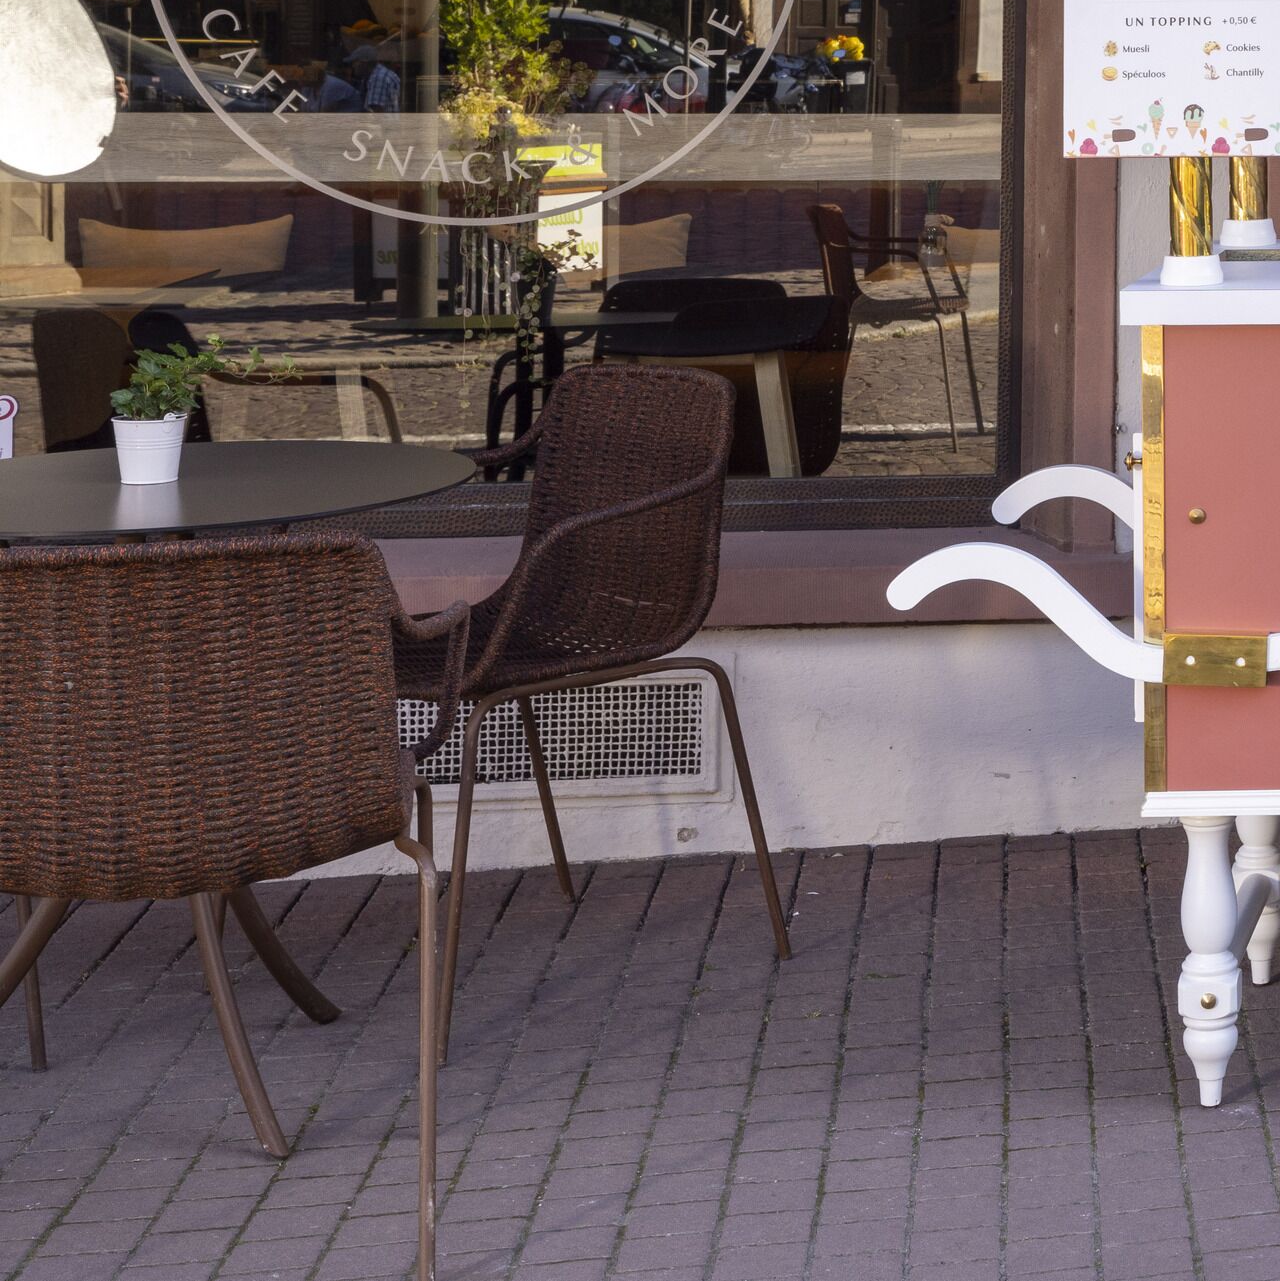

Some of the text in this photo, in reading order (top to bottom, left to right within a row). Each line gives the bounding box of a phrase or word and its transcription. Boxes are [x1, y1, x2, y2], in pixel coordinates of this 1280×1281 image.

[1126, 17, 1143, 26] UN
[1150, 17, 1211, 26] TOPPING
[1123, 45, 1149, 53] Muesli
[1226, 43, 1260, 52] Cookies
[1122, 70, 1166, 80] Spéculoos
[1226, 68, 1264, 78] Chantilly
[202, 8, 743, 184] CAFE SNACK & MORE
